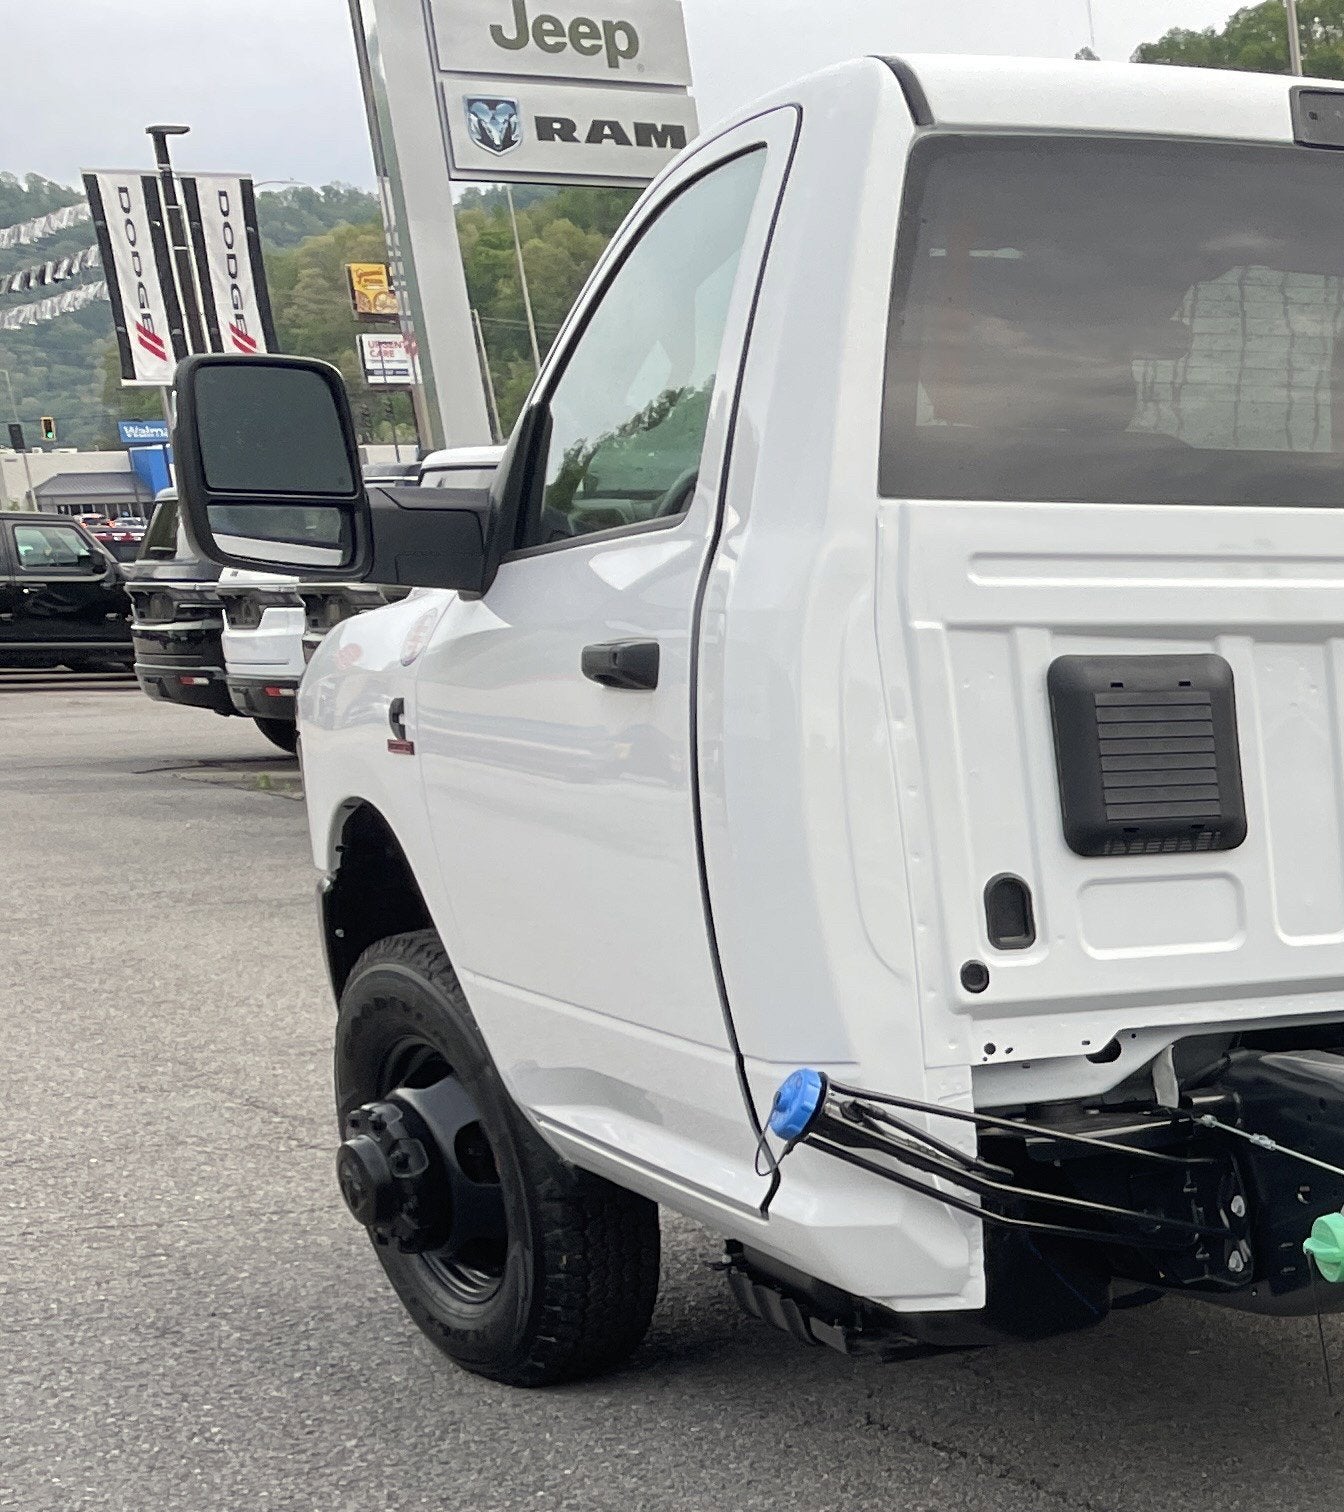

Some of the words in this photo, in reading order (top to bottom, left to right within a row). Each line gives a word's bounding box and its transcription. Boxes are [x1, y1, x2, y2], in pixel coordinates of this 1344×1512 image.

[489, 0, 640, 69] Jeep
[534, 115, 688, 150] RAM
[117, 186, 155, 335] DODGE
[218, 190, 249, 336] DODGE
